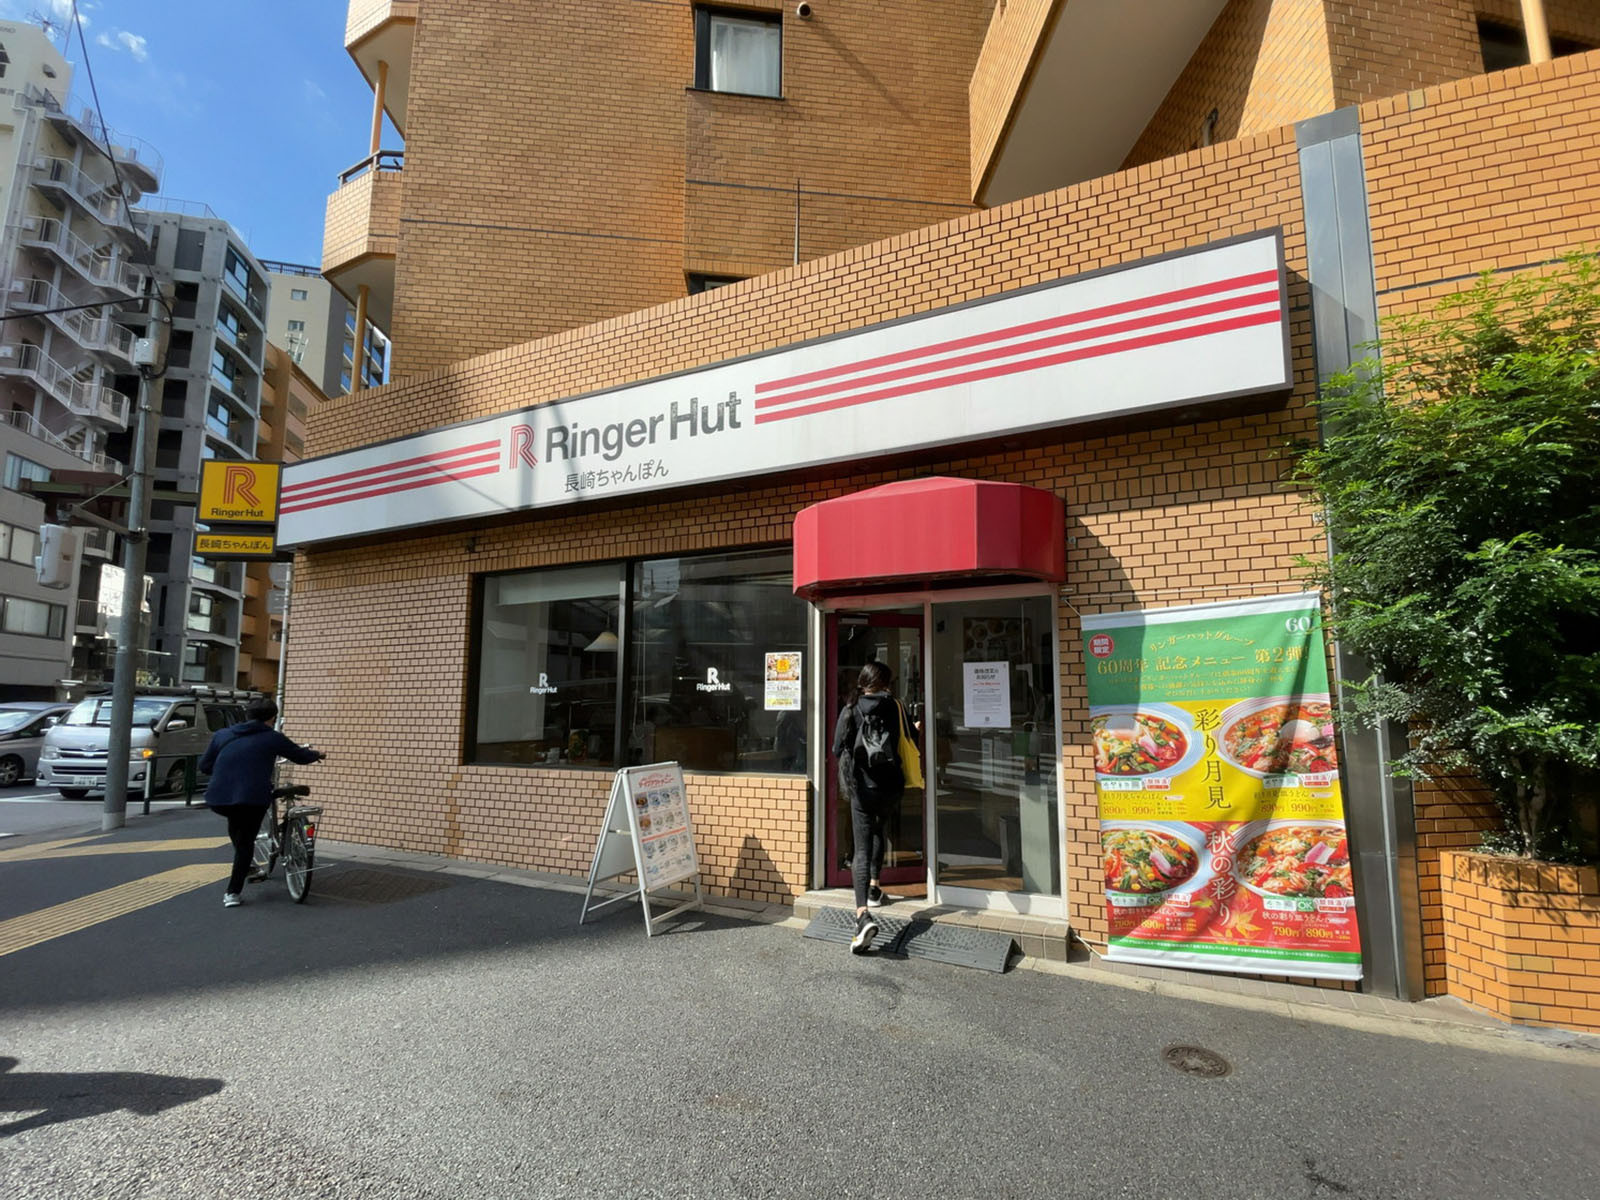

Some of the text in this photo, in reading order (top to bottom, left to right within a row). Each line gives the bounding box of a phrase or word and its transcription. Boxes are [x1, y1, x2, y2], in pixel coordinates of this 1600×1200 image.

[546, 391, 742, 462] Ringer Hut
[564, 459, 669, 493] 長崎ちゃんぽん
[223, 466, 261, 508] R
[211, 508, 264, 518] Ringer Hut
[199, 538, 271, 550] 長崎ちゃんぽん
[1285, 616, 1310, 632] 60
[1097, 658, 1148, 675] 60周年
[1156, 655, 1248, 671] 記念メニュー
[539, 672, 549, 687] R
[707, 667, 719, 684] R
[696, 682, 731, 693] Ringer Hut
[1194, 709, 1231, 809] 彩り月見
[1206, 830, 1239, 926] 秋の彩り
[1298, 901, 1313, 910] OK
[1272, 926, 1300, 937] 790円
[1305, 928, 1333, 939] 890円
